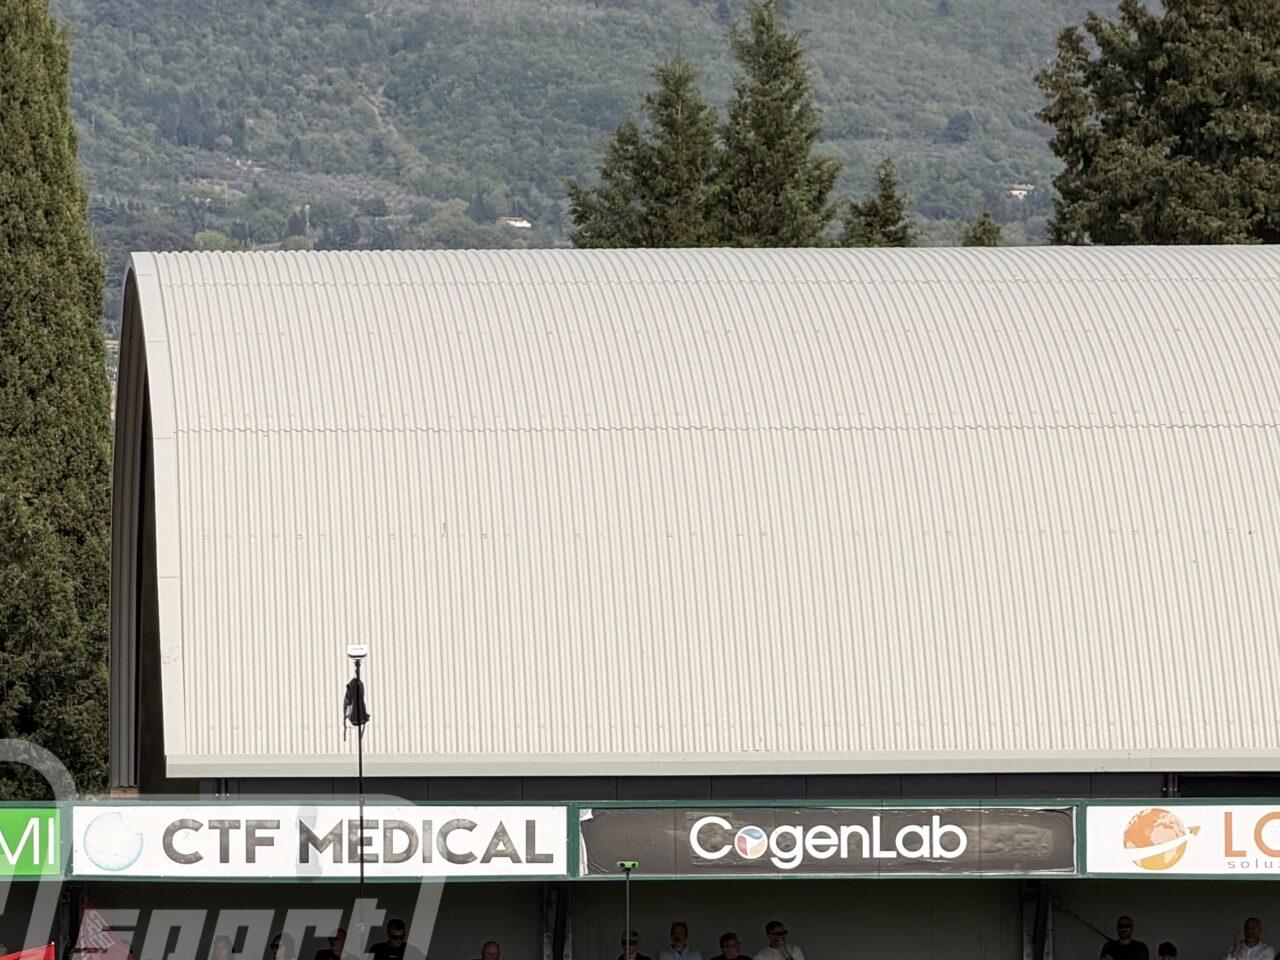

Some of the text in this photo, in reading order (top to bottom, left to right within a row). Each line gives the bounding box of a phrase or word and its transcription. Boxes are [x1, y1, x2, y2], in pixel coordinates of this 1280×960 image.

[162, 818, 554, 864] CTF MEDICAL
[689, 815, 967, 870] CogenLab
[1227, 858, 1280, 869] solu
